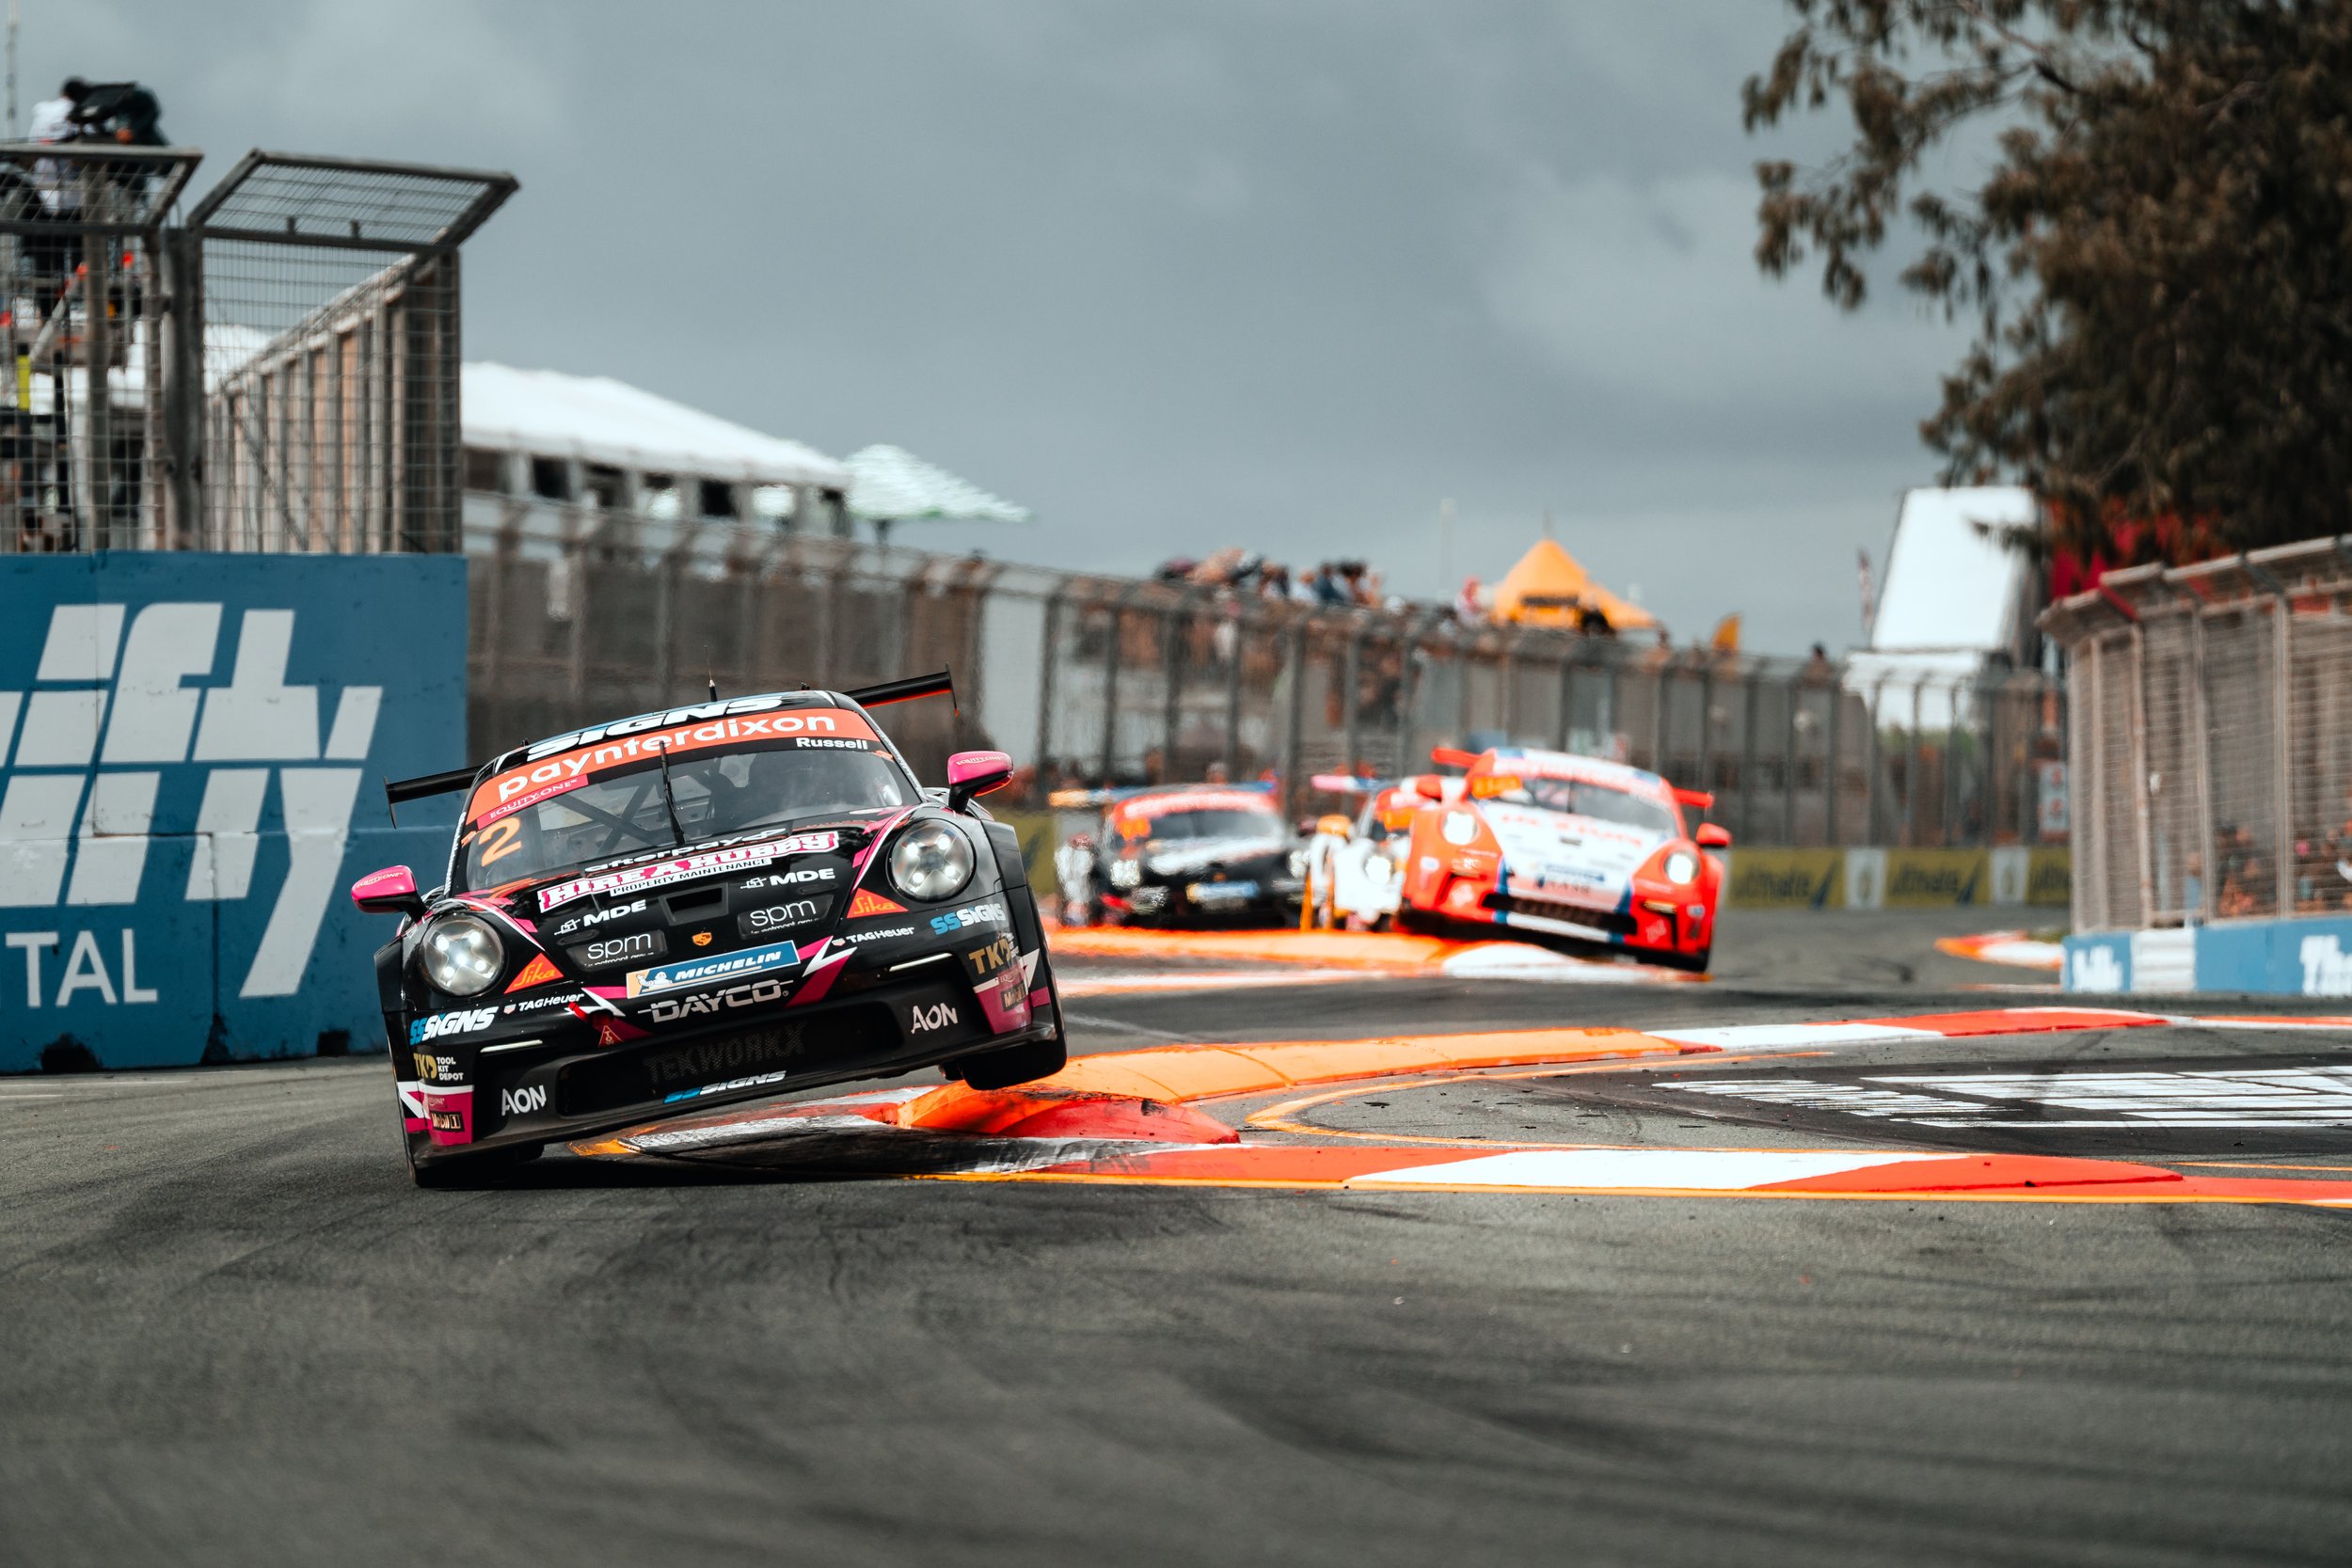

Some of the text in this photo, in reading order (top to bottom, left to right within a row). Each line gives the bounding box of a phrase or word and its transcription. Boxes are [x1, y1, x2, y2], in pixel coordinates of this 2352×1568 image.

[795, 736, 867, 750] Russell
[498, 716, 835, 803] paynterdixon
[0, 601, 384, 999] ifty
[478, 816, 522, 867] 2
[584, 835, 743, 872] afterpay
[543, 832, 833, 909] HIRE A HUBBY
[613, 858, 771, 895] PROPERTY MAINTENANCE
[770, 867, 835, 886] MDE
[583, 899, 646, 927] MDE
[750, 900, 817, 927] spm
[853, 895, 897, 915] Sika
[587, 933, 652, 960] spm
[514, 962, 556, 988] Sika
[674, 950, 782, 981] MICHELIN
[649, 978, 783, 1023] DAYCO
[911, 1002, 959, 1034] AON
[413, 1053, 437, 1079] TKD
[436, 1056, 456, 1065] TOOL
[438, 1072, 464, 1081] DEPOT
[501, 1085, 548, 1117] AON
